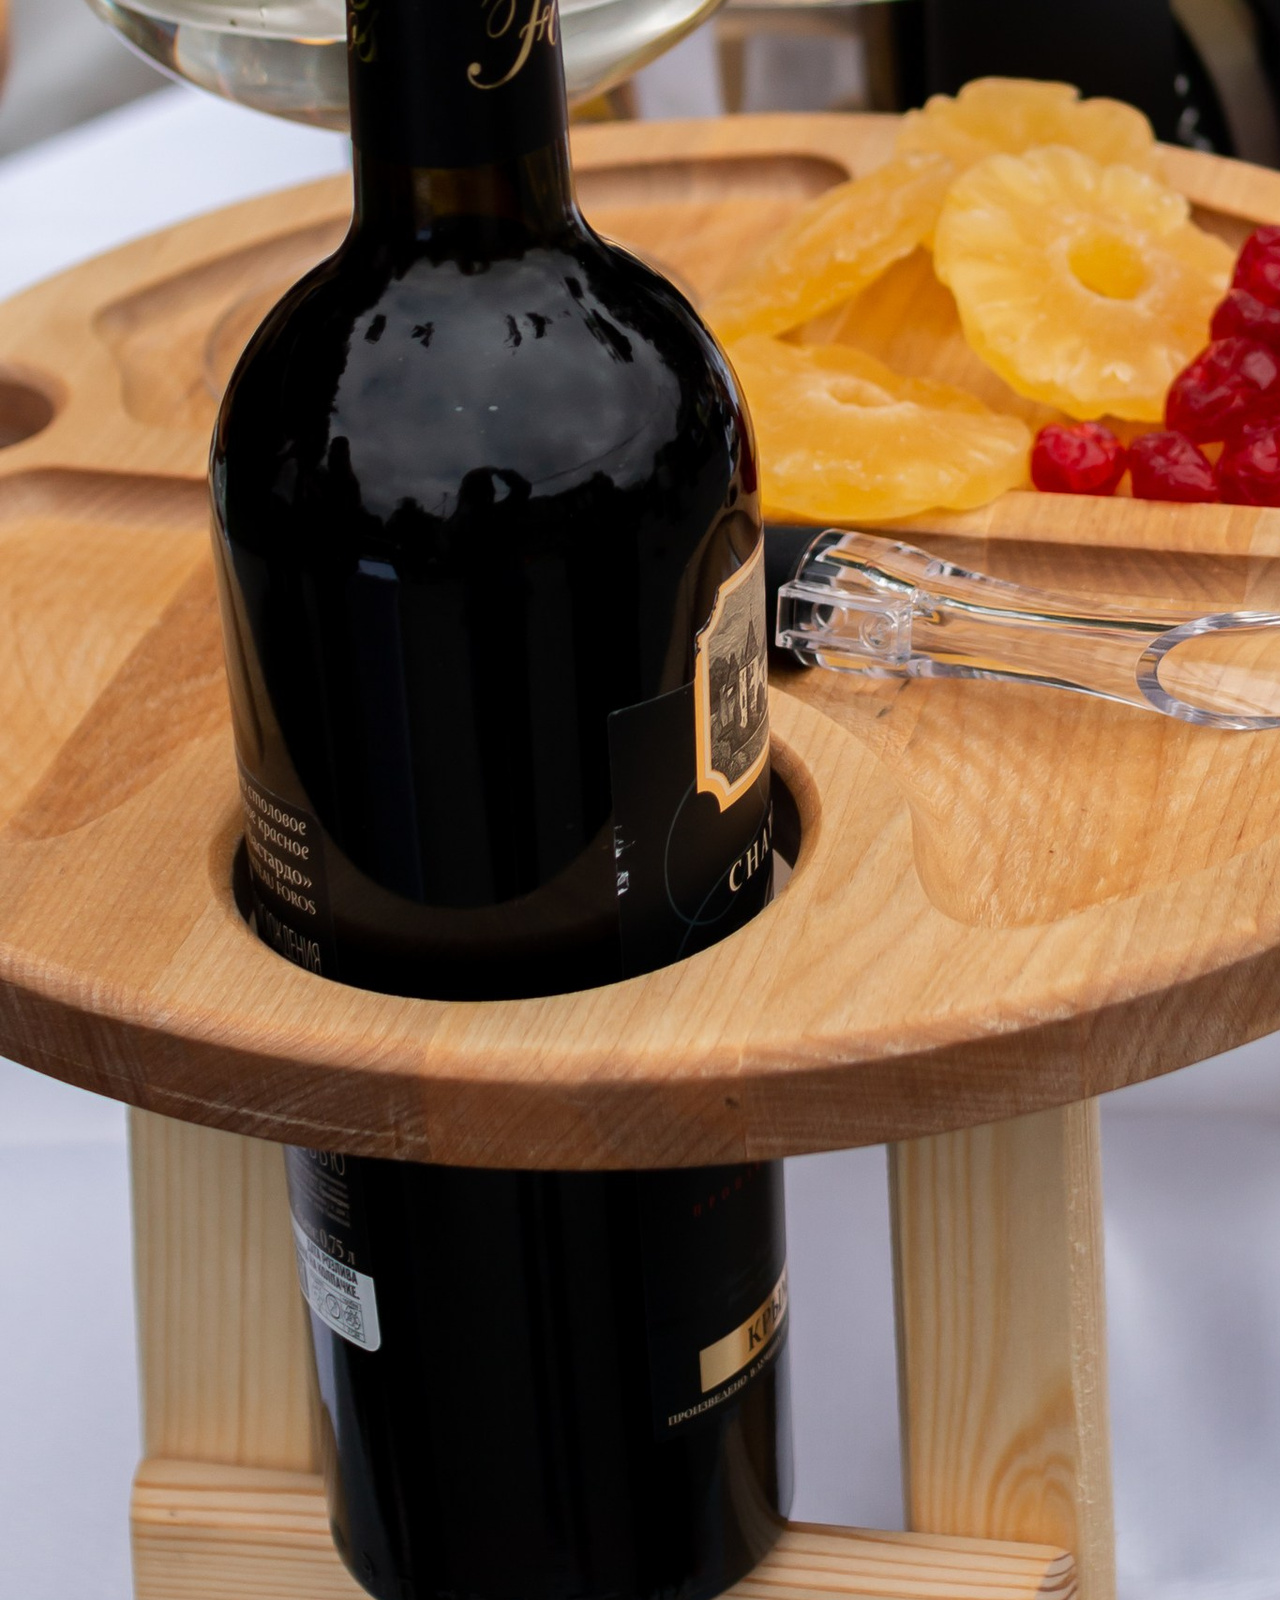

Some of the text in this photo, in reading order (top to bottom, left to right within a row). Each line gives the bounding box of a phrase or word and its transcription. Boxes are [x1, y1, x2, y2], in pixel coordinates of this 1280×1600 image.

[247, 827, 313, 889] астардо»
[258, 815, 310, 861] красное
[276, 879, 317, 917] FOROS
[668, 1375, 748, 1426] ПРОИЗВЕДЕНО
